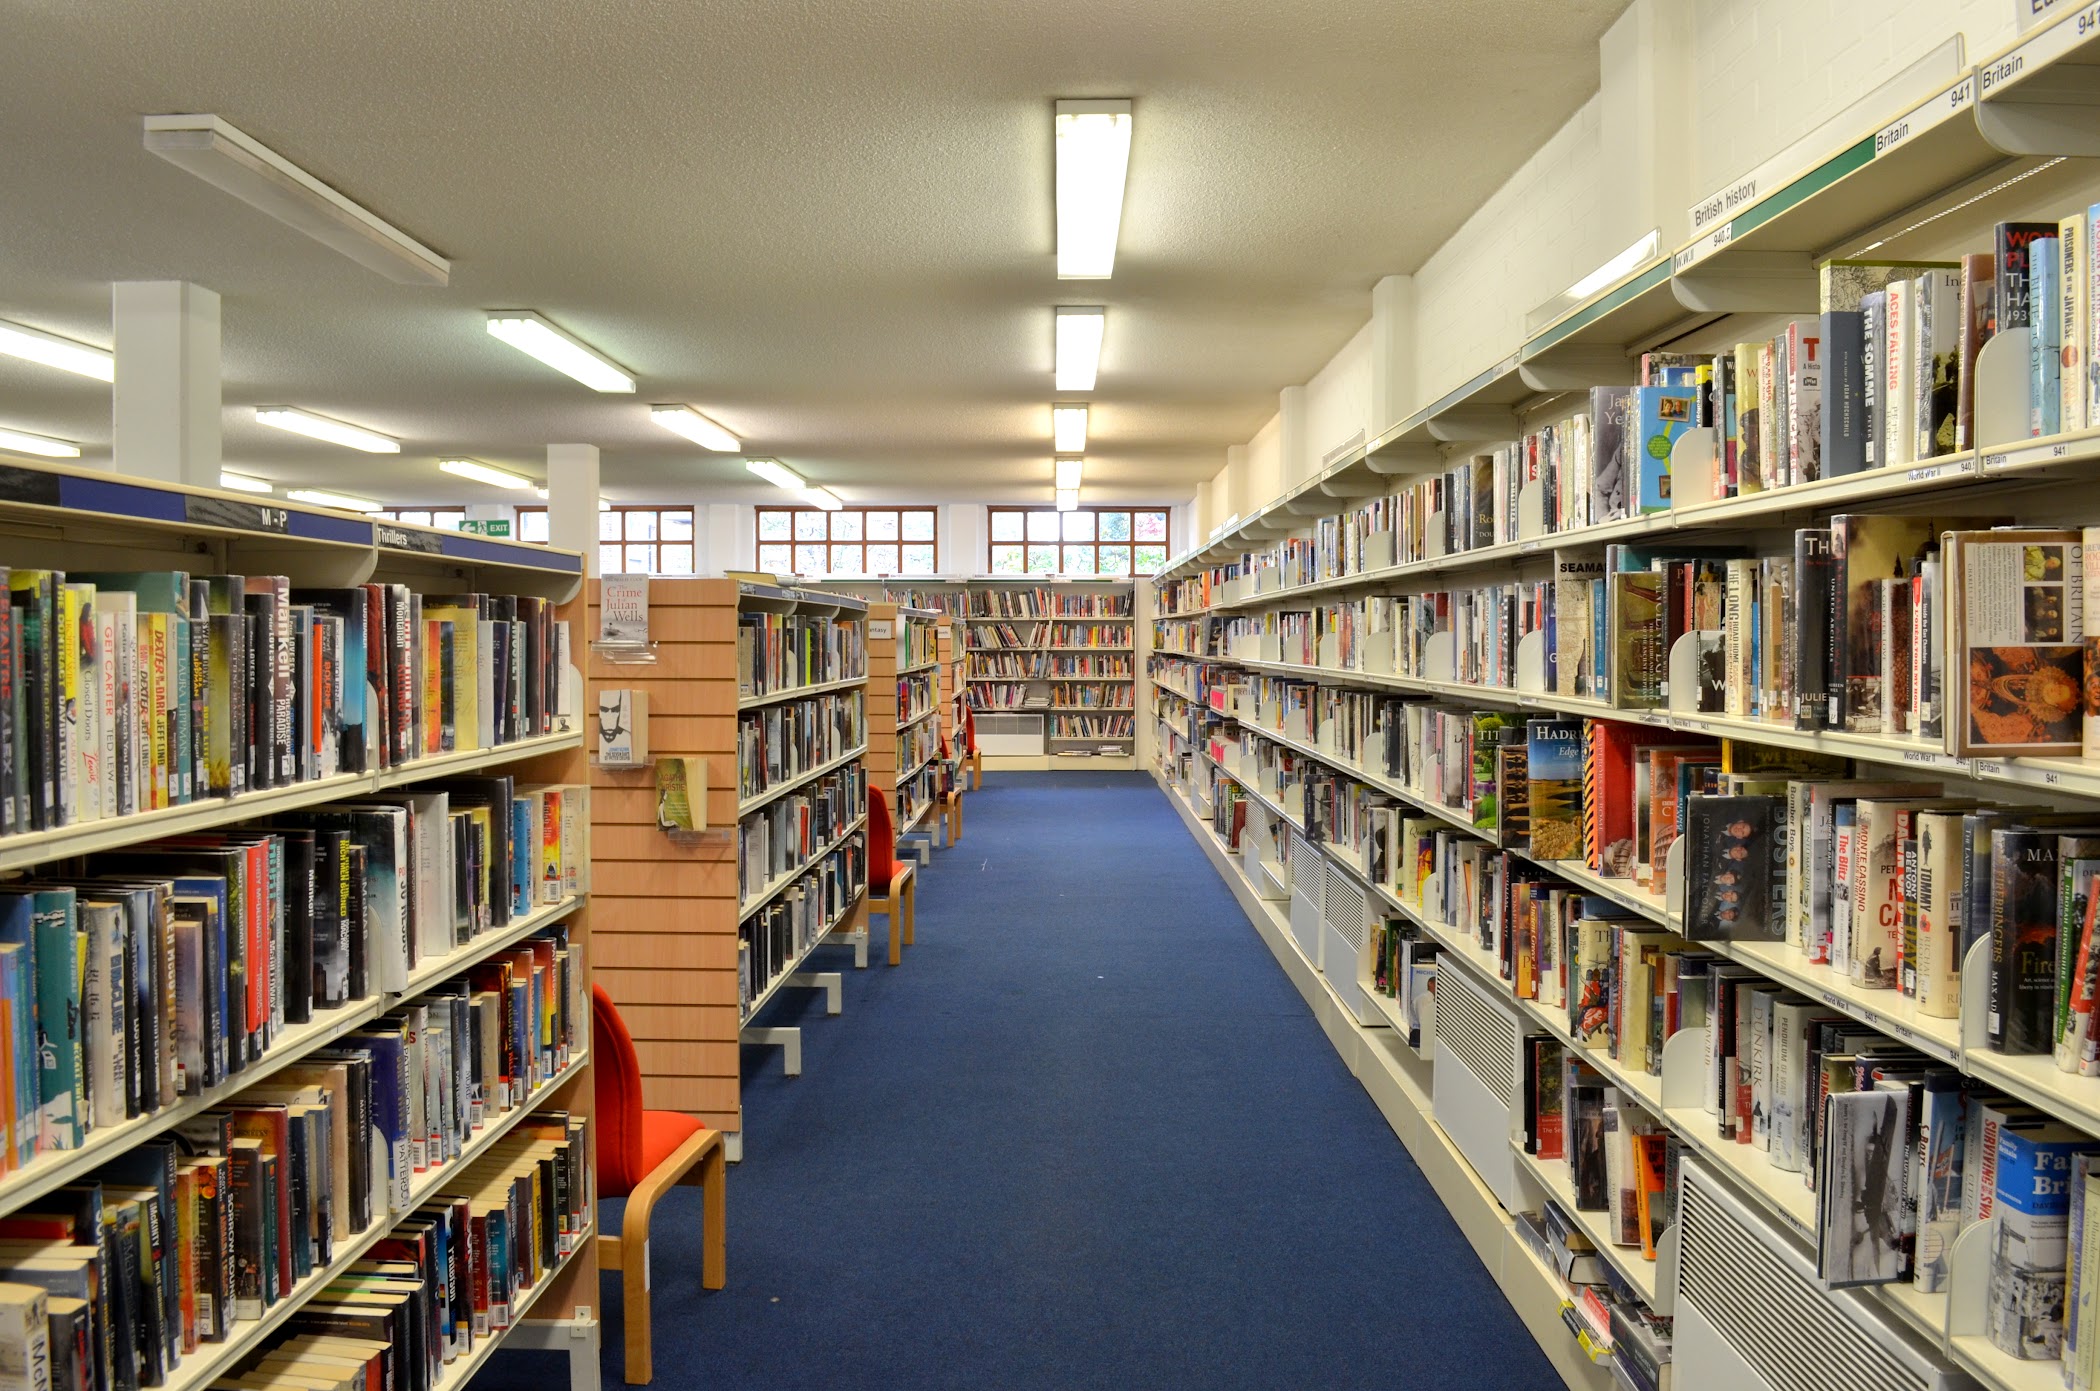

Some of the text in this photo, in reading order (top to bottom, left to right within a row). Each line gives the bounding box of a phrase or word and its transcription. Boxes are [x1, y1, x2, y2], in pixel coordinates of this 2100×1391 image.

[1951, 56, 2023, 107] Britain 941
[1876, 123, 1909, 152] Britain
[1695, 180, 1756, 227] British history
[2064, 227, 2074, 340] PRISONERS JAPANESE
[1864, 307, 1873, 340] THE
[1889, 293, 1899, 390] ACES FALLING
[1864, 343, 1874, 407] SOMME
[1986, 446, 2065, 465] Britain 941
[377, 527, 407, 546] Thrillers
[490, 524, 508, 532] EXIT
[57, 584, 65, 609] THE
[607, 586, 642, 597] Crime
[1729, 569, 1739, 584] THE
[2071, 545, 2083, 643] OF BRITAIN
[606, 599, 637, 611] Julian
[613, 610, 643, 622] Wells
[1728, 588, 1739, 620] LONG
[58, 614, 66, 687] CONTRACT
[277, 588, 290, 677] Mankell
[104, 627, 114, 751] GET CARTER TED
[154, 630, 165, 741] DEXTER DARK JEFF
[324, 661, 332, 709] BOURNE
[1913, 673, 1918, 687] MY
[84, 671, 92, 741] Closed Doors
[122, 703, 130, 739] Watch
[178, 658, 187, 757] LAURA LIPPMAN
[276, 699, 285, 745] PARADISE
[2, 711, 12, 776] ALEX
[1559, 747, 1579, 758] Edge
[1904, 752, 1919, 761] World
[1980, 763, 2058, 784] Britain 941
[1789, 786, 1797, 825] Bomber
[1701, 813, 1710, 925] JONATHAN FALCONER
[1838, 834, 1849, 881] The Blitz
[1858, 824, 1868, 912] MONTE CASSINO
[1920, 868, 1932, 912] TOMMY
[166, 912, 175, 944] KEN
[1904, 901, 1918, 970] D-DAY
[1994, 870, 2005, 963] FIREBRINGERS
[2060, 926, 2068, 980] DEVONSHIRE
[1753, 1007, 1762, 1088] DUNKIRK
[1780, 1064, 1786, 1075] OF
[398, 1144, 409, 1208] PATTERSON
[1981, 1119, 1997, 1187] SURVIVING
[1966, 1174, 1975, 1222] CITIZEN
[149, 1206, 160, 1247] McKINTY
